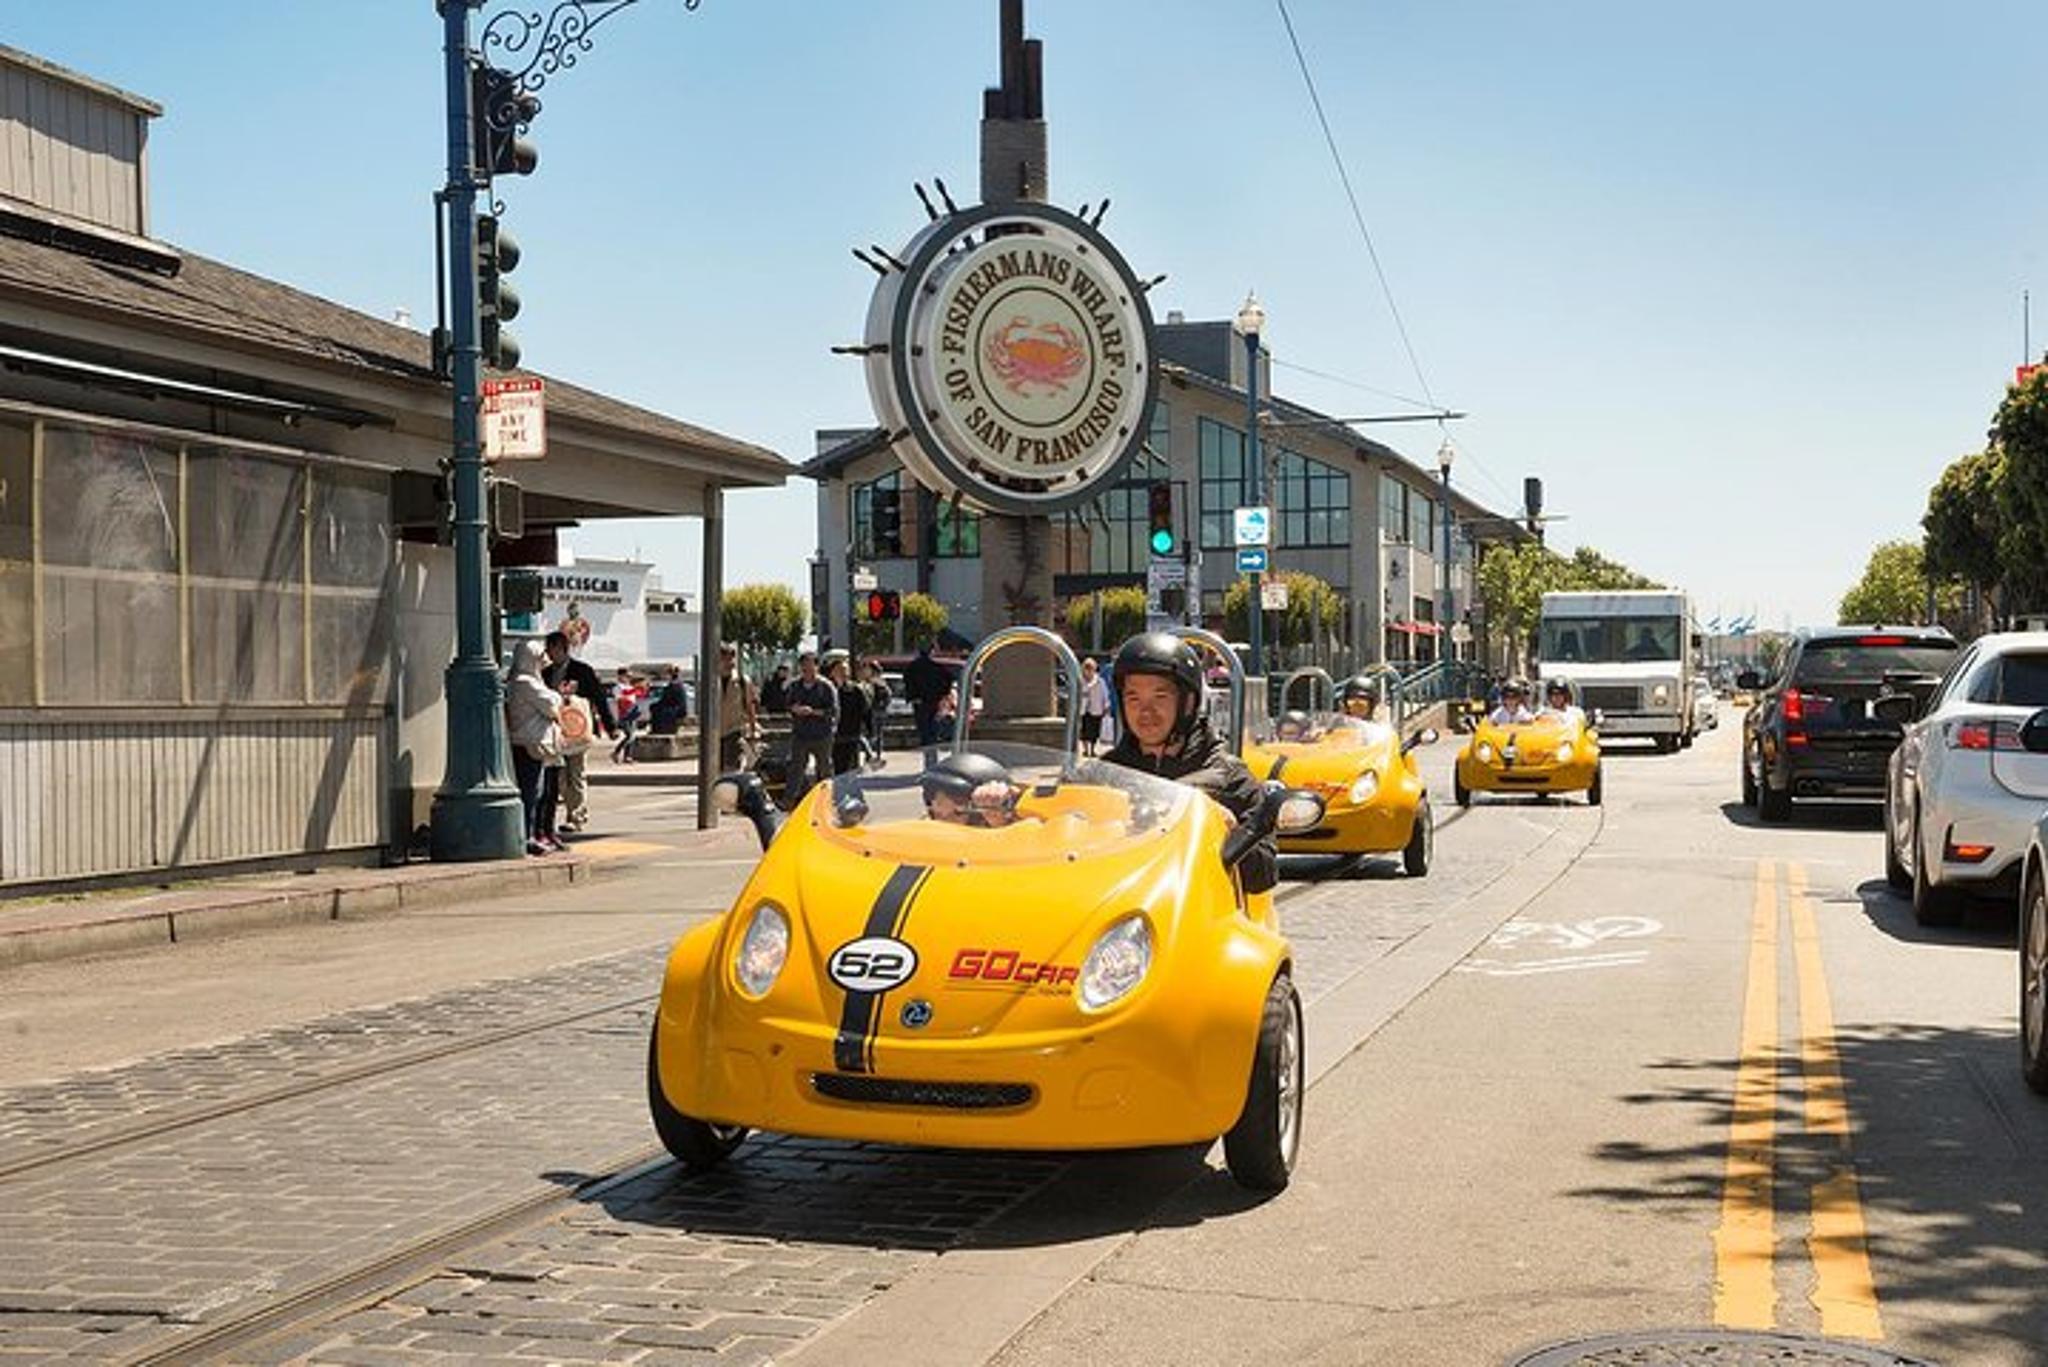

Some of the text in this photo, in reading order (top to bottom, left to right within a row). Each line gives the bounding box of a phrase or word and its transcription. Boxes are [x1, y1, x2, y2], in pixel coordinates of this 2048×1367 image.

[942, 251, 1126, 368] FISHERMANS WHARF
[946, 368, 1123, 464] OF SAN FRANCISCO
[837, 952, 905, 980] 52
